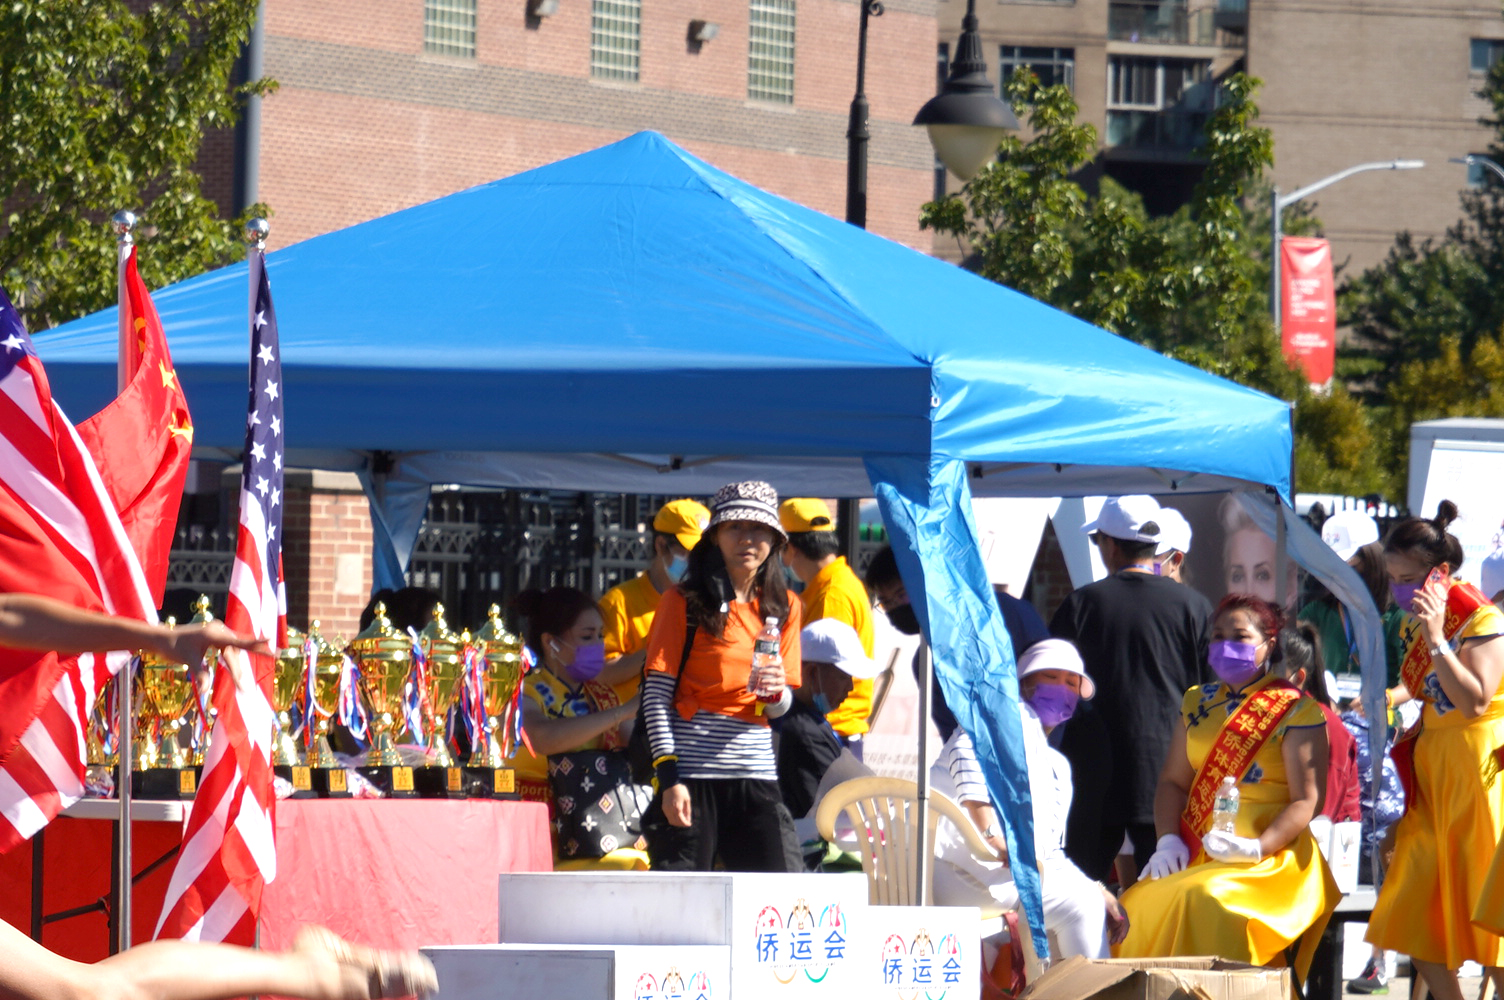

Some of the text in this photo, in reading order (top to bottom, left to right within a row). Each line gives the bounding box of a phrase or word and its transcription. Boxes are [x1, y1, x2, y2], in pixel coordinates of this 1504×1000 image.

[756, 929, 847, 963] 侨运会
[883, 956, 962, 984] 侨运会
